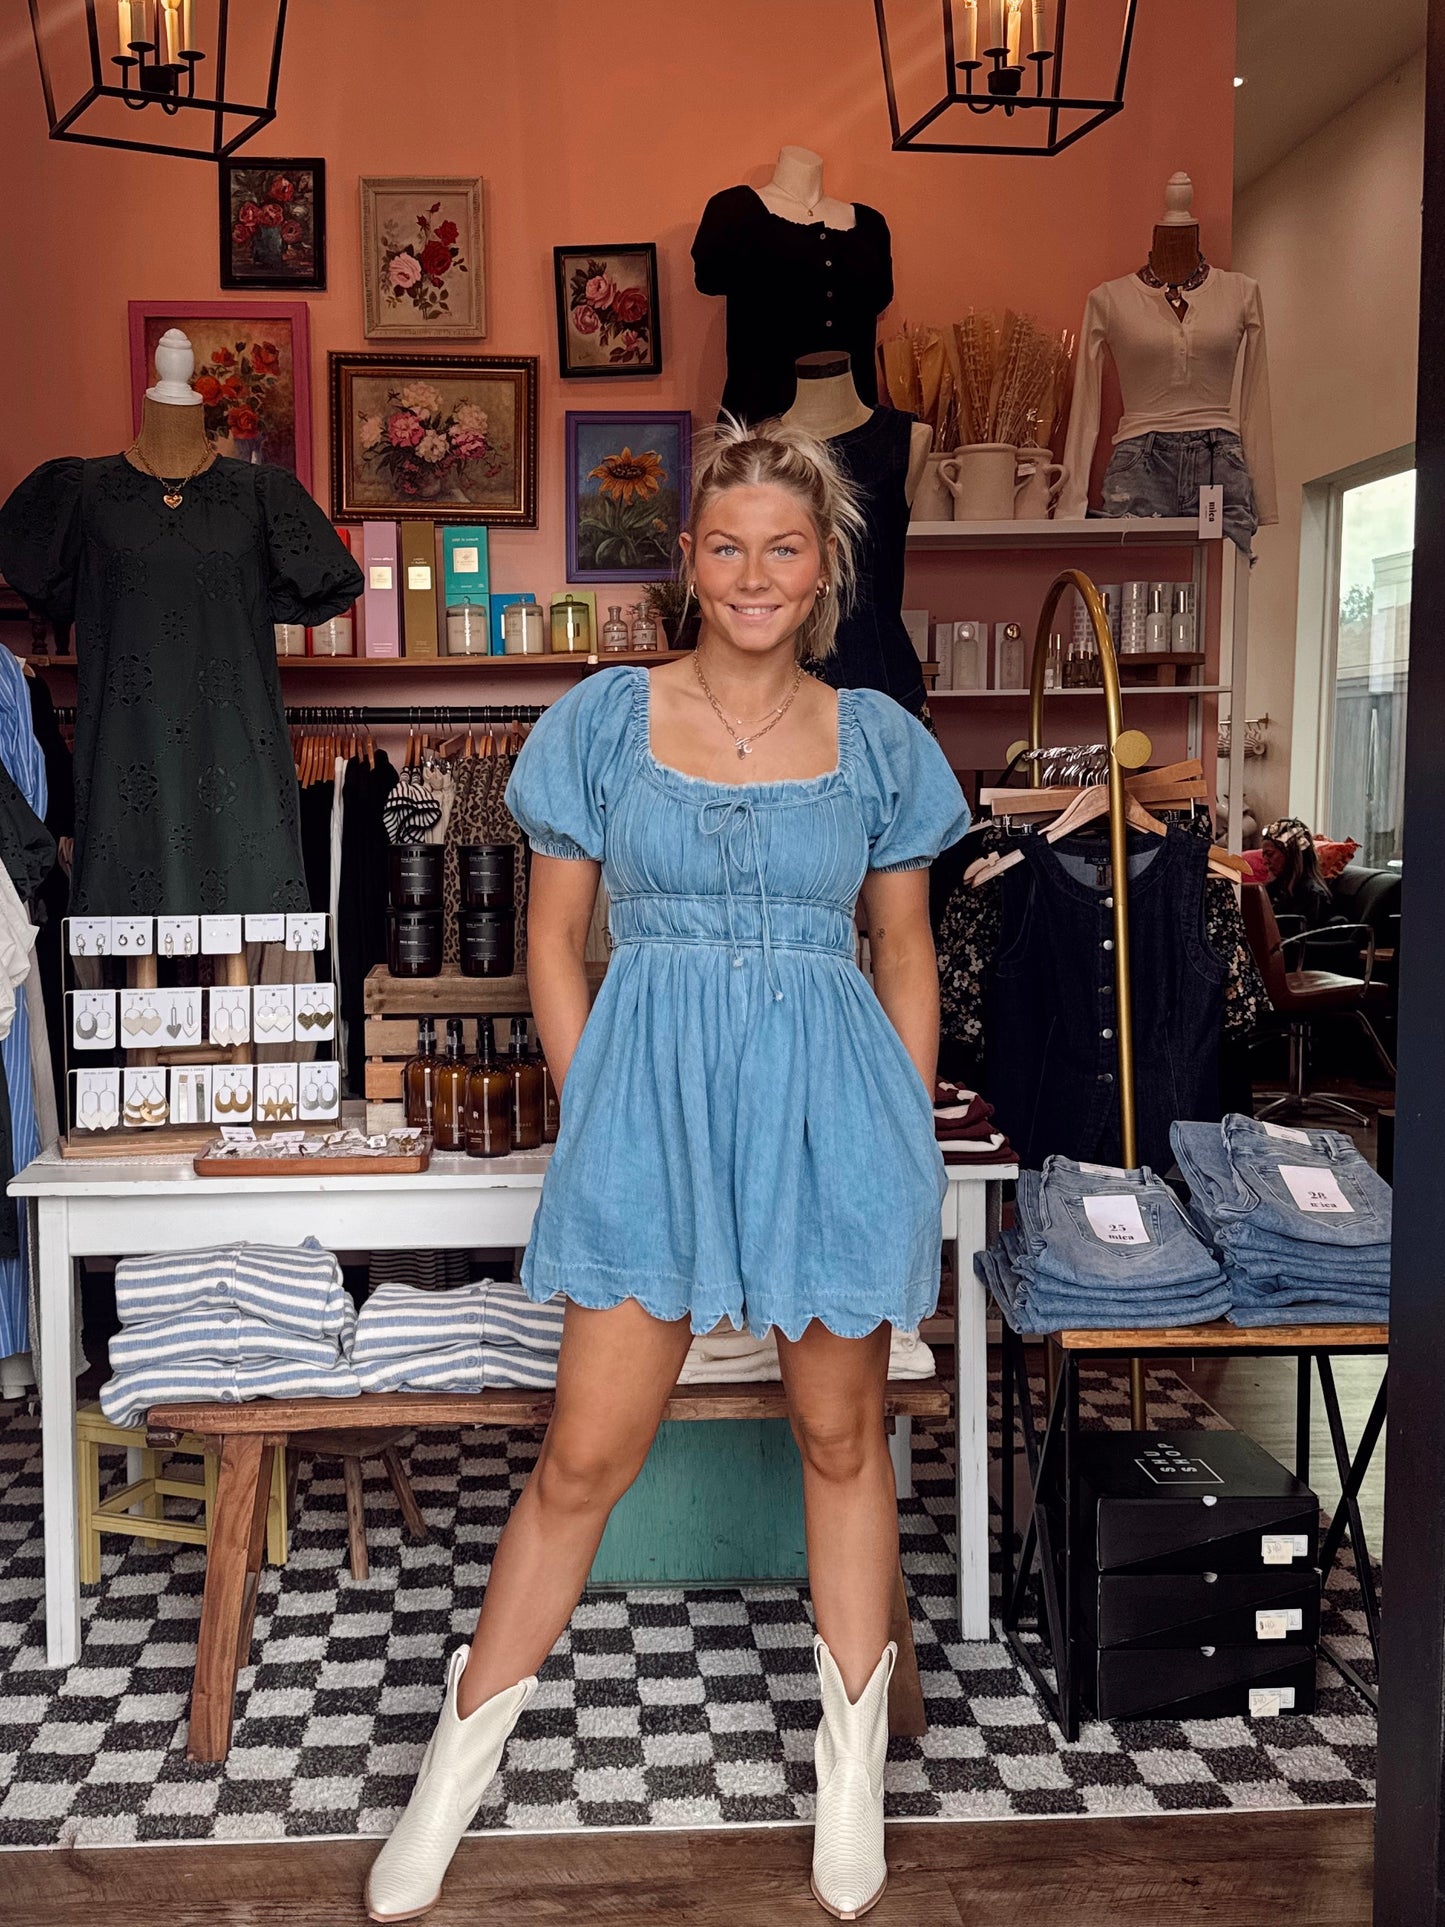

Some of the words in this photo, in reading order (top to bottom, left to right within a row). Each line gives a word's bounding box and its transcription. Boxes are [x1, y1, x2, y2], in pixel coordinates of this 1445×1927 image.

[1208, 502, 1217, 523] mica
[1108, 1224, 1127, 1232] 25
[1143, 1450, 1176, 1473] SHU
[1157, 1442, 1198, 1472] SHOP
